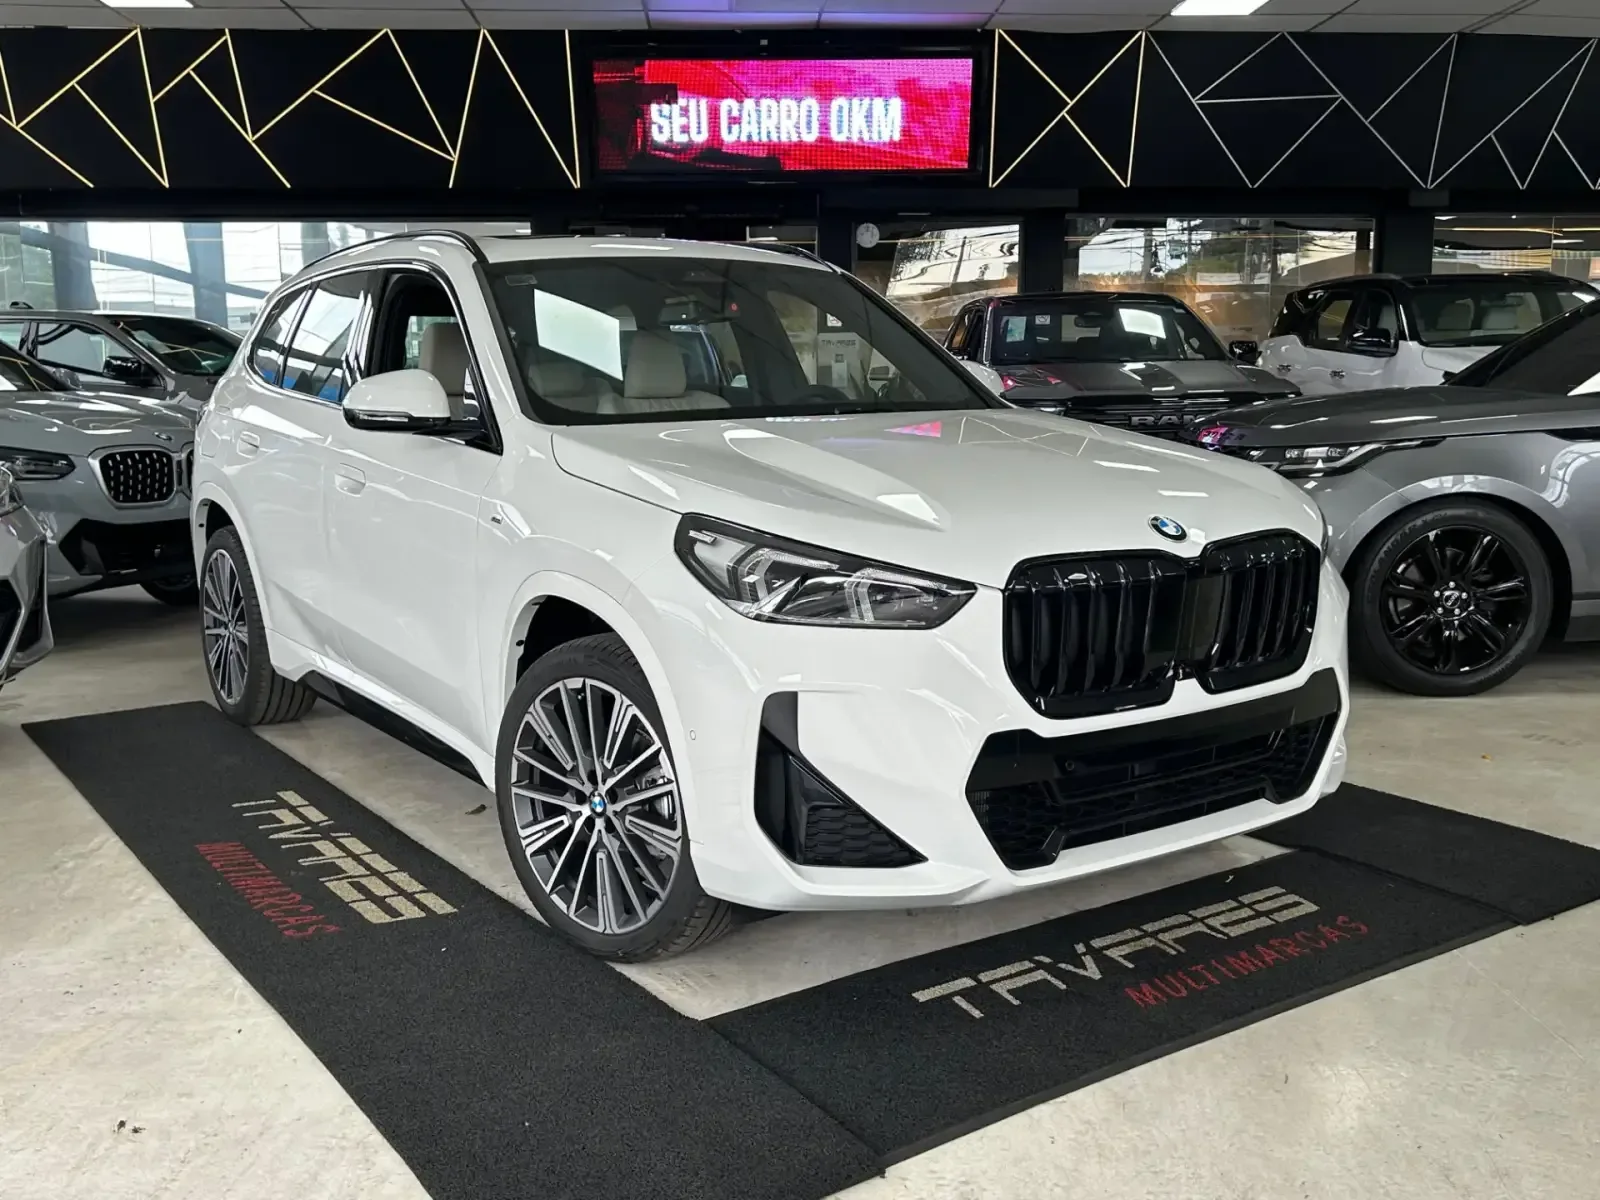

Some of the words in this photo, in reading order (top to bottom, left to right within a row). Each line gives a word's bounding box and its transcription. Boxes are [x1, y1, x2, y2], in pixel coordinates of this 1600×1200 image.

[650, 97, 708, 143] SEU
[719, 97, 819, 142] CARRO
[911, 885, 1321, 1019] TAVARES
[1124, 914, 1369, 1010] MULTIMARCAS
